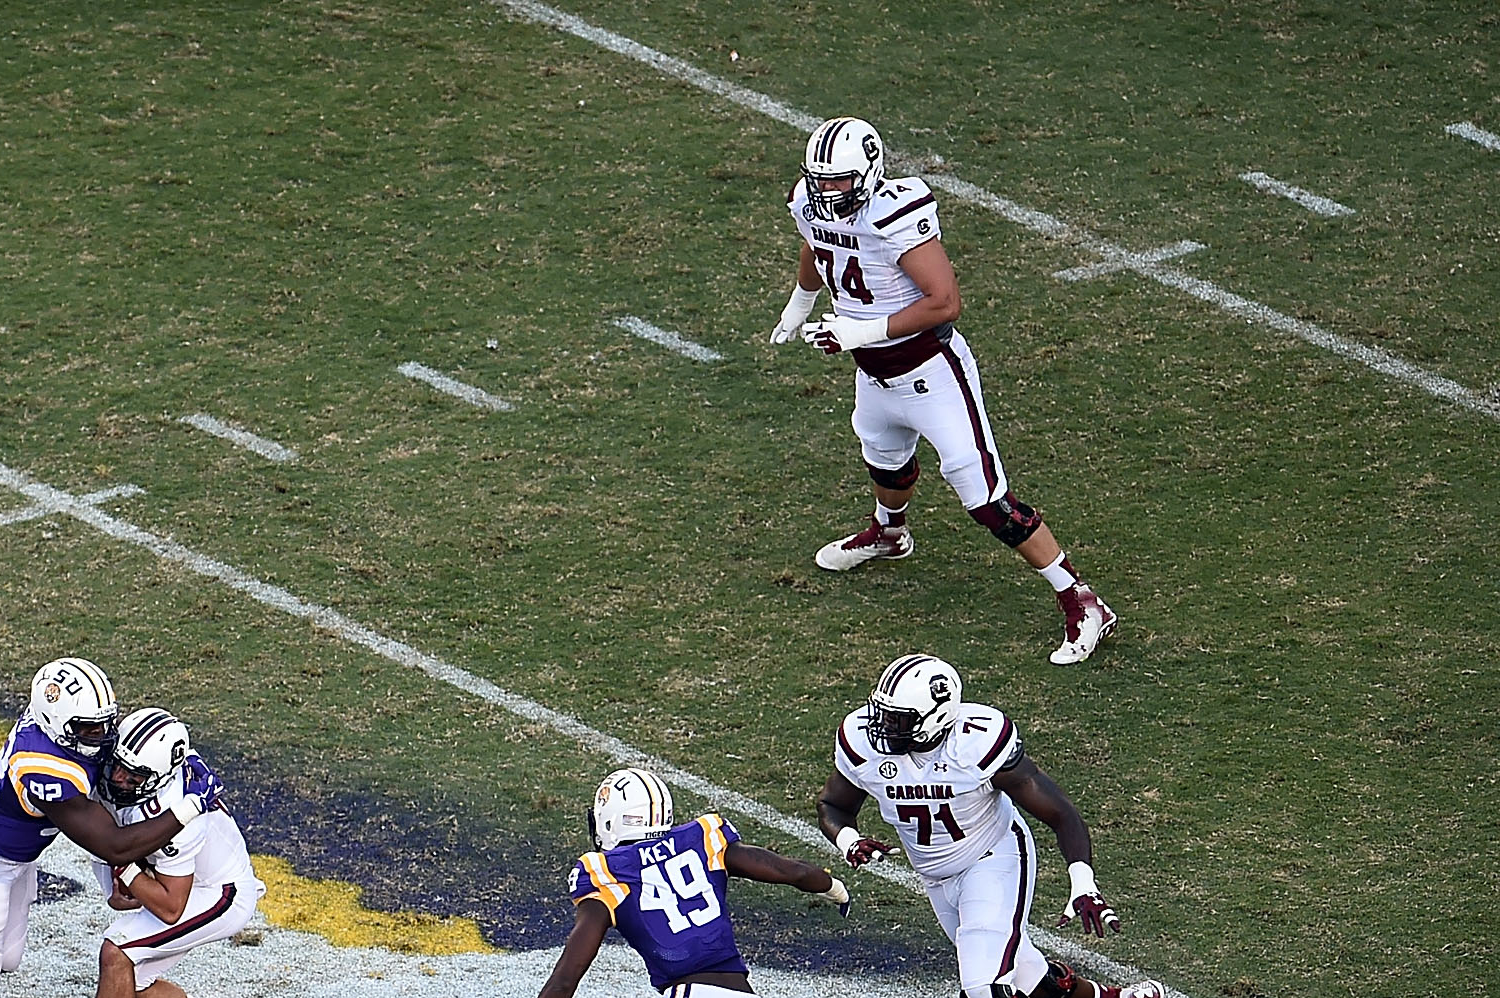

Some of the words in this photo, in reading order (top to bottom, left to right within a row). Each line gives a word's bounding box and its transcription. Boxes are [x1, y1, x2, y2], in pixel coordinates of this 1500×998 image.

[810, 226, 860, 251] CAROLINA
[814, 245, 875, 305] 74
[36, 668, 83, 696] LSU
[963, 716, 993, 734] 71
[29, 779, 63, 801] 92
[885, 785, 955, 801] CAROLINA
[895, 803, 967, 847] 71
[638, 837, 677, 866] KEY
[639, 849, 722, 934] 49
